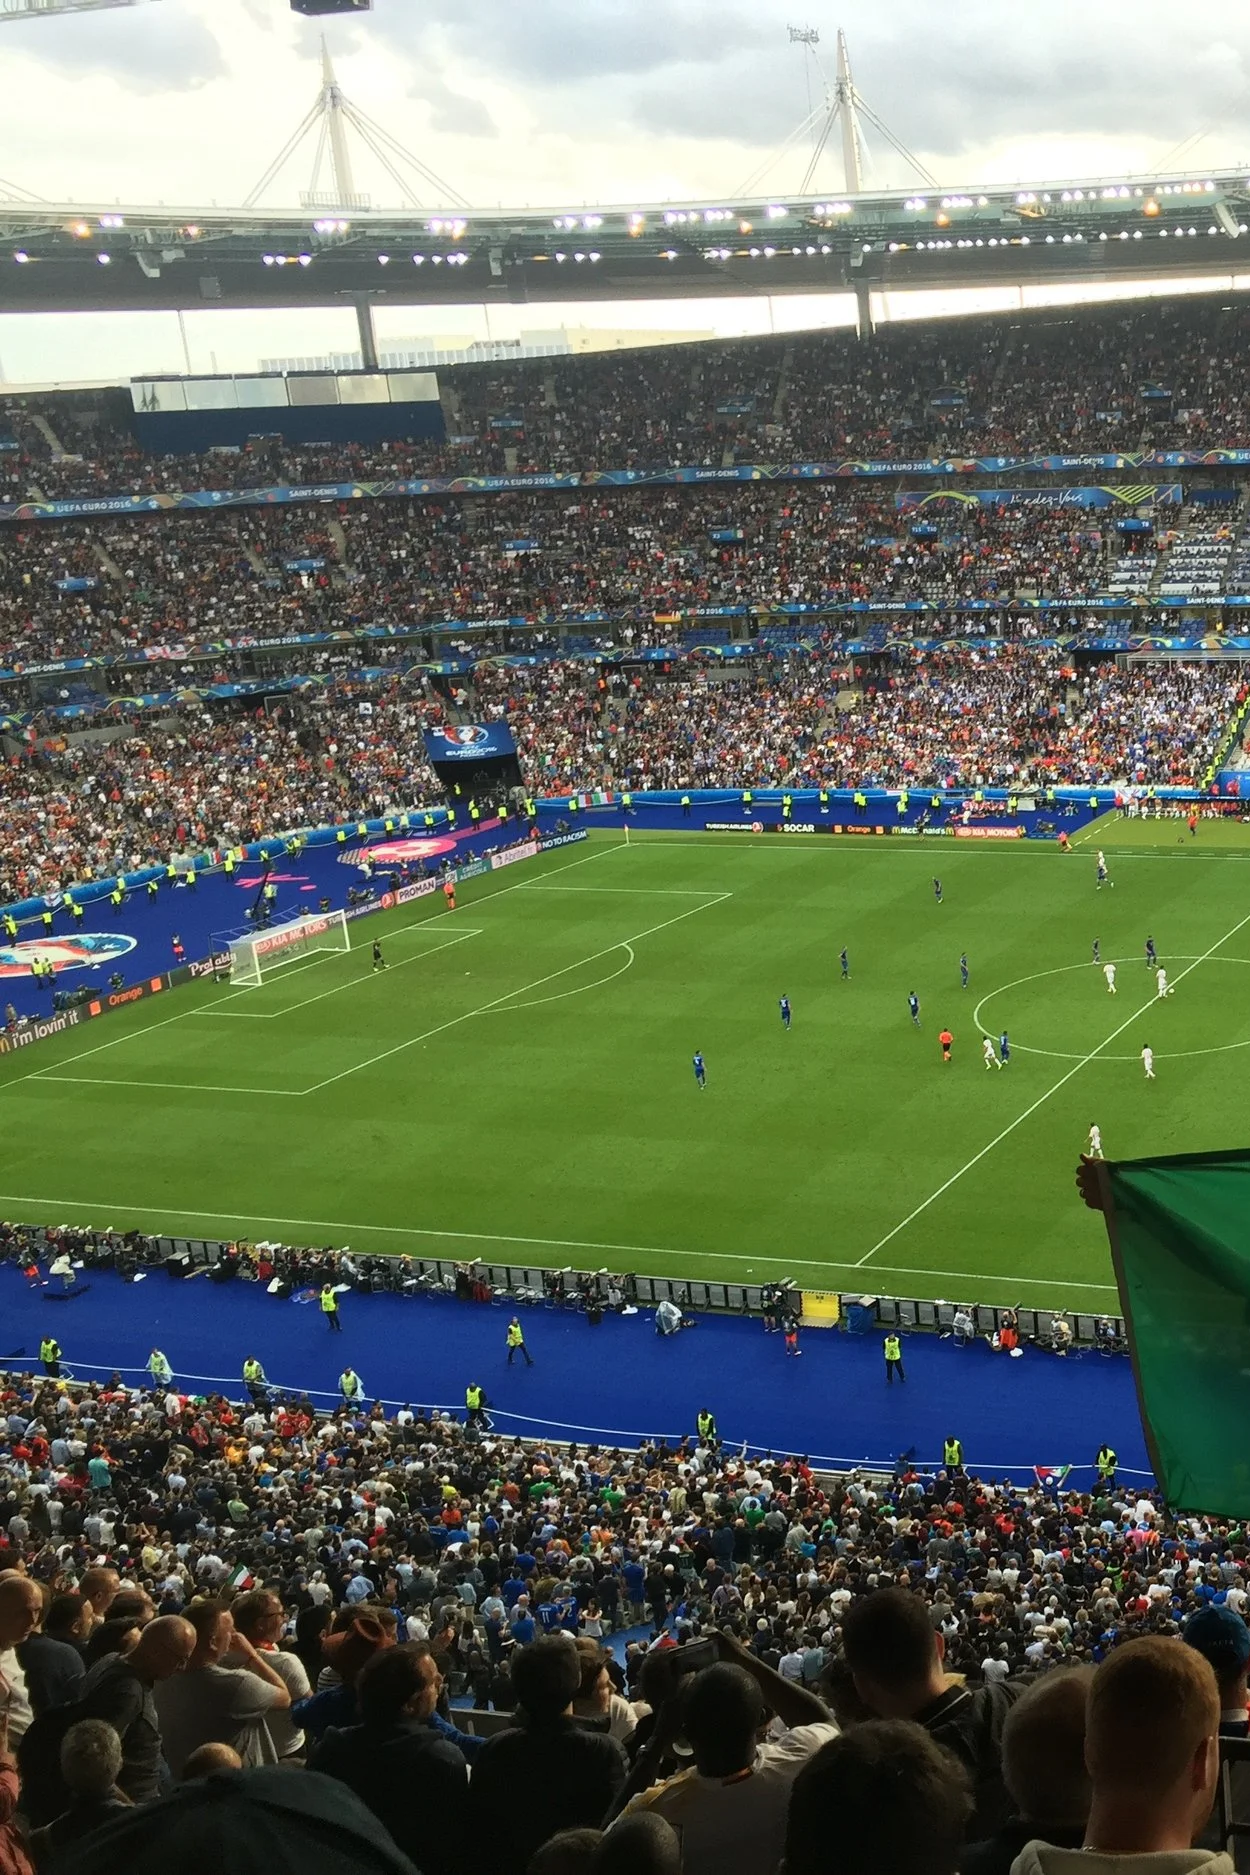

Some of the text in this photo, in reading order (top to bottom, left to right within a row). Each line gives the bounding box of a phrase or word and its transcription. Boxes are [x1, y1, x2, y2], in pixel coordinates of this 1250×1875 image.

[871, 464, 891, 472] UEFA
[913, 463, 931, 471] 2016
[695, 469, 740, 478] SAINT-DENIS
[487, 476, 554, 487] UEFA EURO 2016
[288, 487, 338, 498] SAINT-DENIS
[57, 500, 131, 513] UEFA EURO 2016
[705, 607, 723, 616] 2016
[869, 602, 906, 610] SAINT-DENIS
[467, 619, 510, 629] SAINT-DENIS
[259, 638, 280, 647] EURO
[281, 636, 300, 645] 2016
[783, 824, 815, 833] SOCAR
[847, 826, 871, 834] Orange
[972, 828, 985, 837] KIA
[986, 828, 1018, 837] MOTORS
[542, 830, 587, 849] NO TO RACISM
[400, 880, 435, 899] PROMAN
[271, 934, 288, 948] KIA
[109, 987, 143, 1006] Orange
[12, 1031, 33, 1049] i'm
[69, 1009, 79, 1026] it
